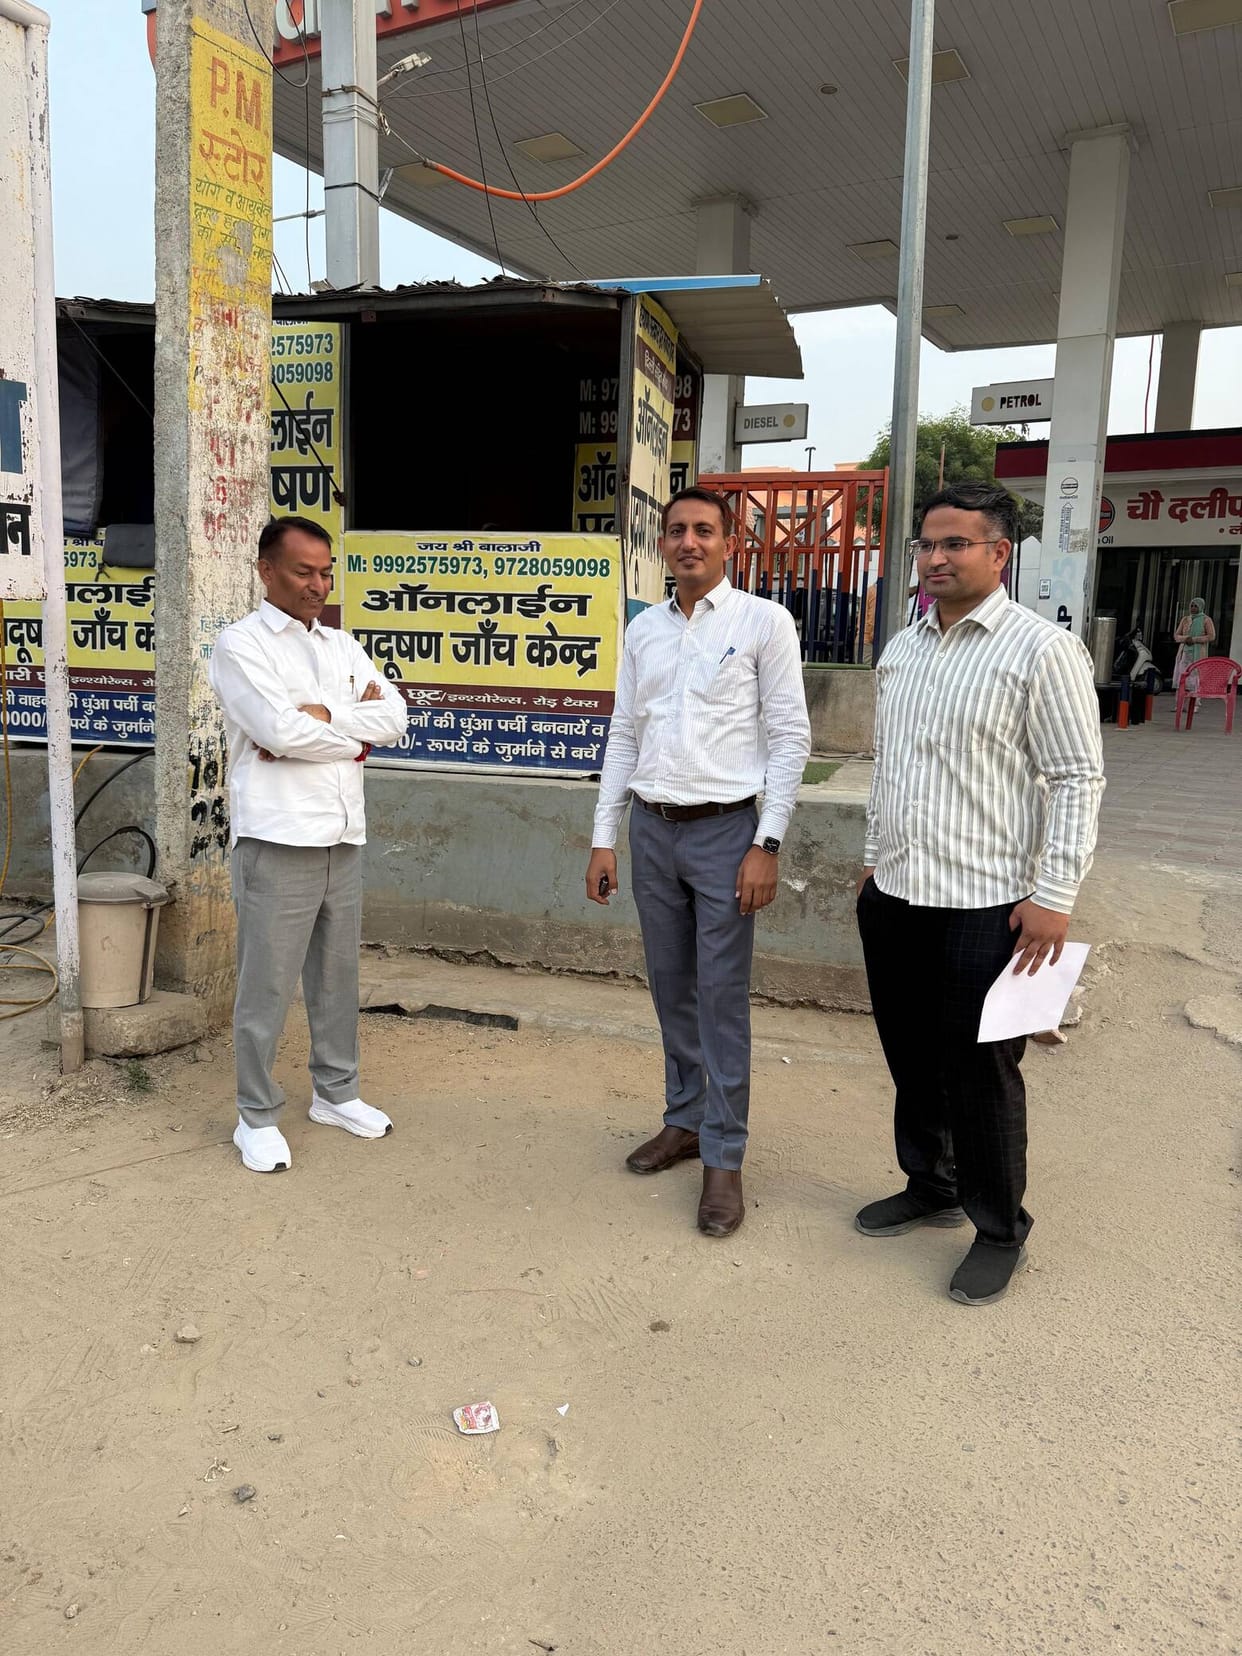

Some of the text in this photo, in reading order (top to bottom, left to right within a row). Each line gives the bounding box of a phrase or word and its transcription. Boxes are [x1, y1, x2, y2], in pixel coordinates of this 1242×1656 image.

[999, 393, 1042, 410] PETROL
[271, 390, 334, 455] लाईन
[743, 415, 779, 429] DIESEL
[271, 466, 334, 512] षण
[417, 540, 541, 553] जय श्री बालाजी
[347, 555, 611, 579] M: 9992575973, 9728059098
[65, 576, 155, 607] लाई
[361, 583, 592, 618] ऑनलाईन
[71, 607, 128, 651] जाँच
[450, 618, 518, 666] जाँच
[525, 621, 601, 677] केन्द्र
[93, 717, 108, 731] के
[433, 711, 455, 728] की
[497, 715, 528, 733] पर्ची
[531, 718, 591, 736] बनवायें
[591, 724, 606, 737] व
[472, 737, 491, 754] के
[494, 739, 546, 762] जुर्माने
[550, 741, 567, 758] से
[571, 743, 601, 760] बचें
